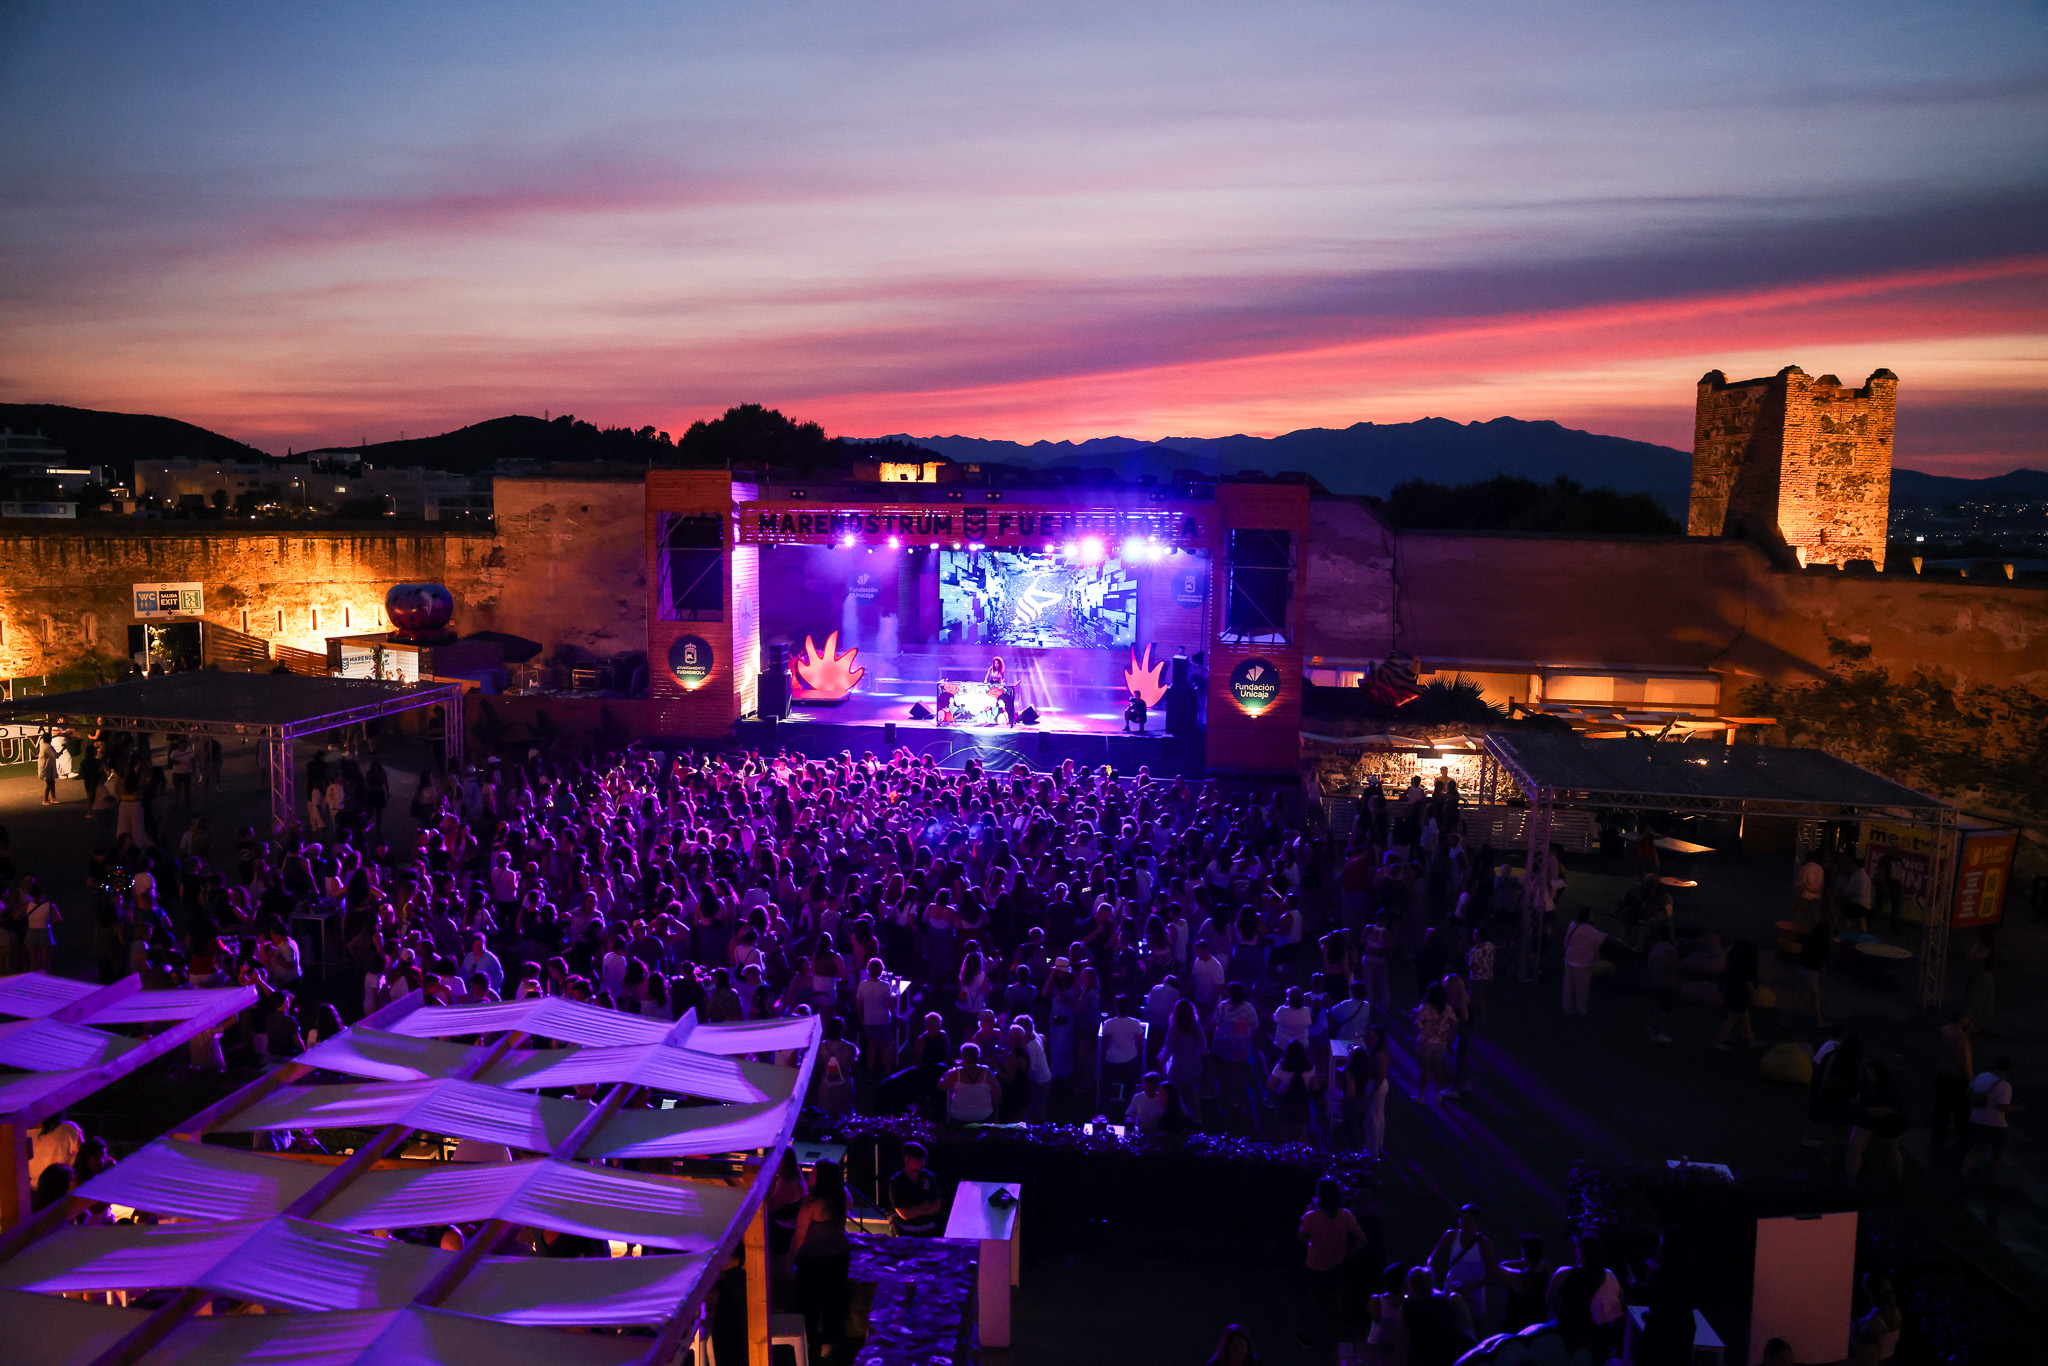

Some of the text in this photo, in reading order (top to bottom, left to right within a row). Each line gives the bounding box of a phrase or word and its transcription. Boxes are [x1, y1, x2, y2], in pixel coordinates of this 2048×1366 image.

[758, 513, 951, 535] MARENOSTRUM
[138, 592, 156, 601] WC
[160, 598, 178, 606] EXIT
[1235, 682, 1275, 691] Fundación
[1240, 690, 1269, 700] Unicaja
